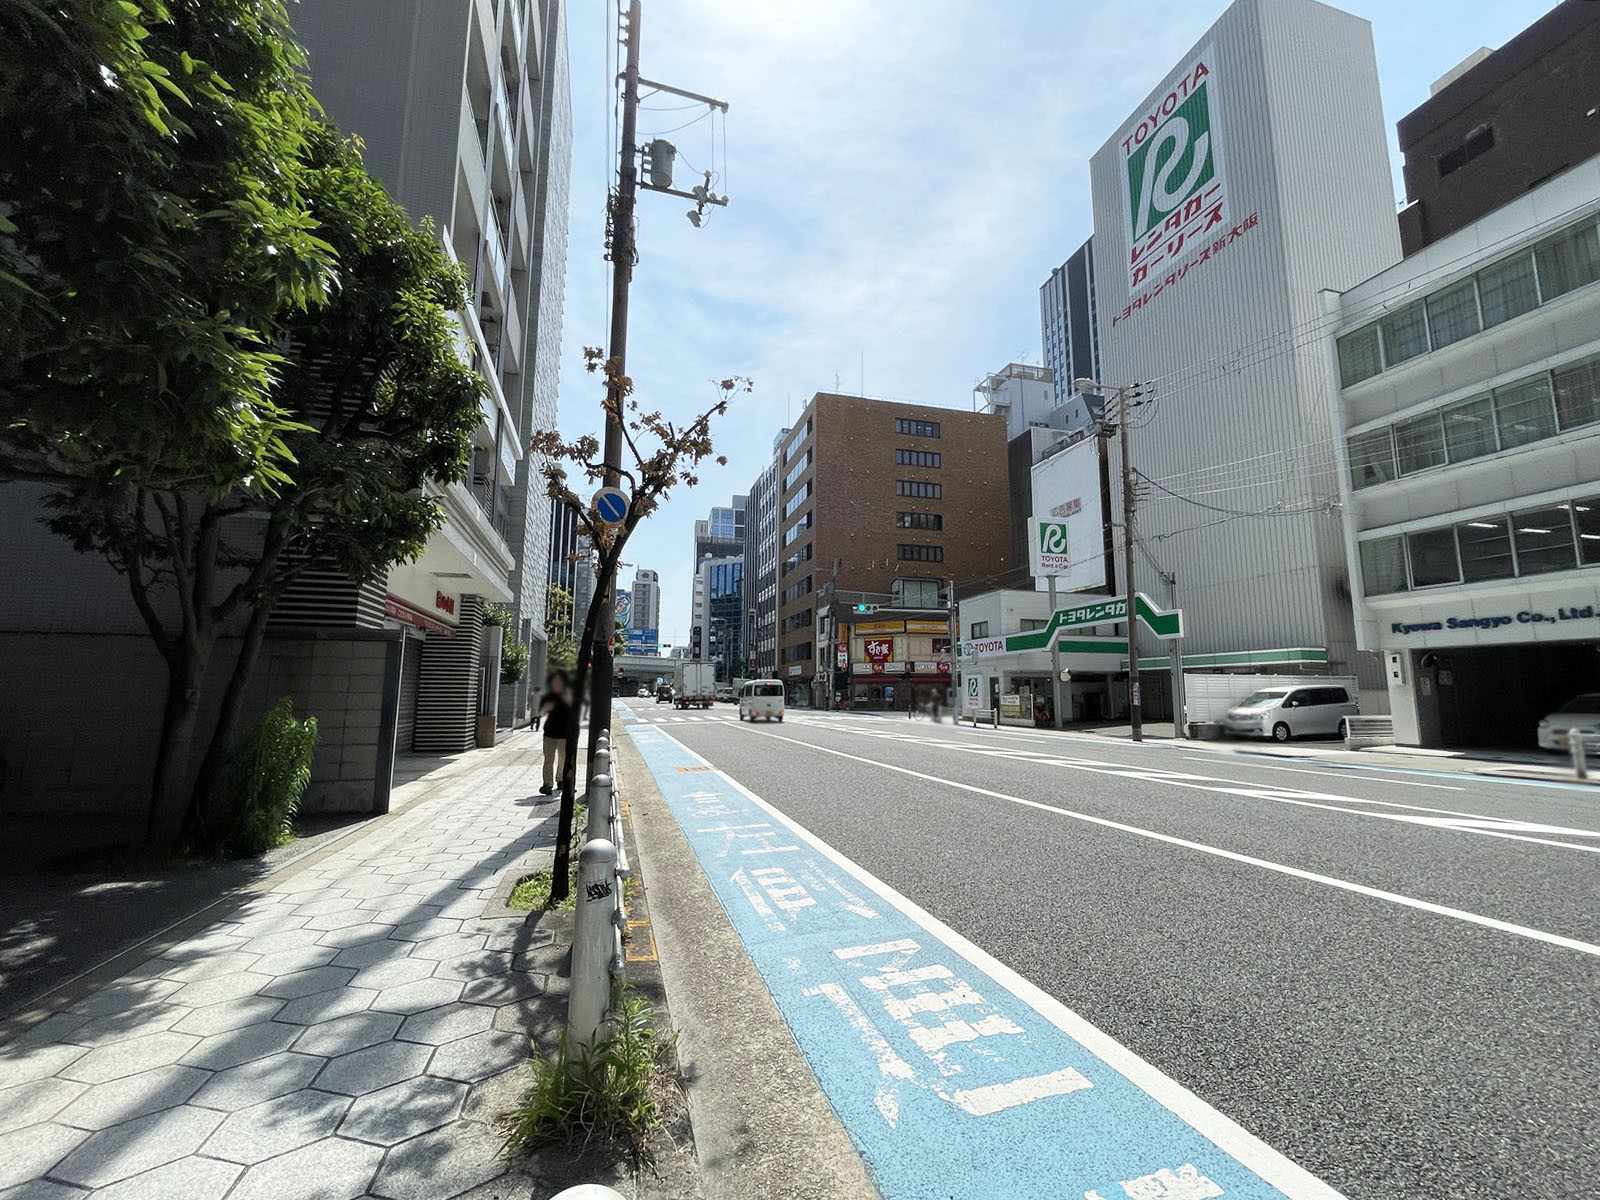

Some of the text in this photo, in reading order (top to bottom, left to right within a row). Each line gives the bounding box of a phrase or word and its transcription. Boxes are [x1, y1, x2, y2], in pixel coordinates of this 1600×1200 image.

[1122, 61, 1210, 155] TOYOTA
[1131, 183, 1221, 265] レンタカー
[1132, 202, 1223, 288] カーリース
[1112, 212, 1259, 327] トヨタレンタリース新大阪
[1059, 602, 1128, 624] トヨタレンタカ
[1391, 606, 1600, 635] Kyowa Sangyo Co., Ltd.
[867, 640, 889, 656] すき家
[974, 641, 1003, 652] TOYOTA
